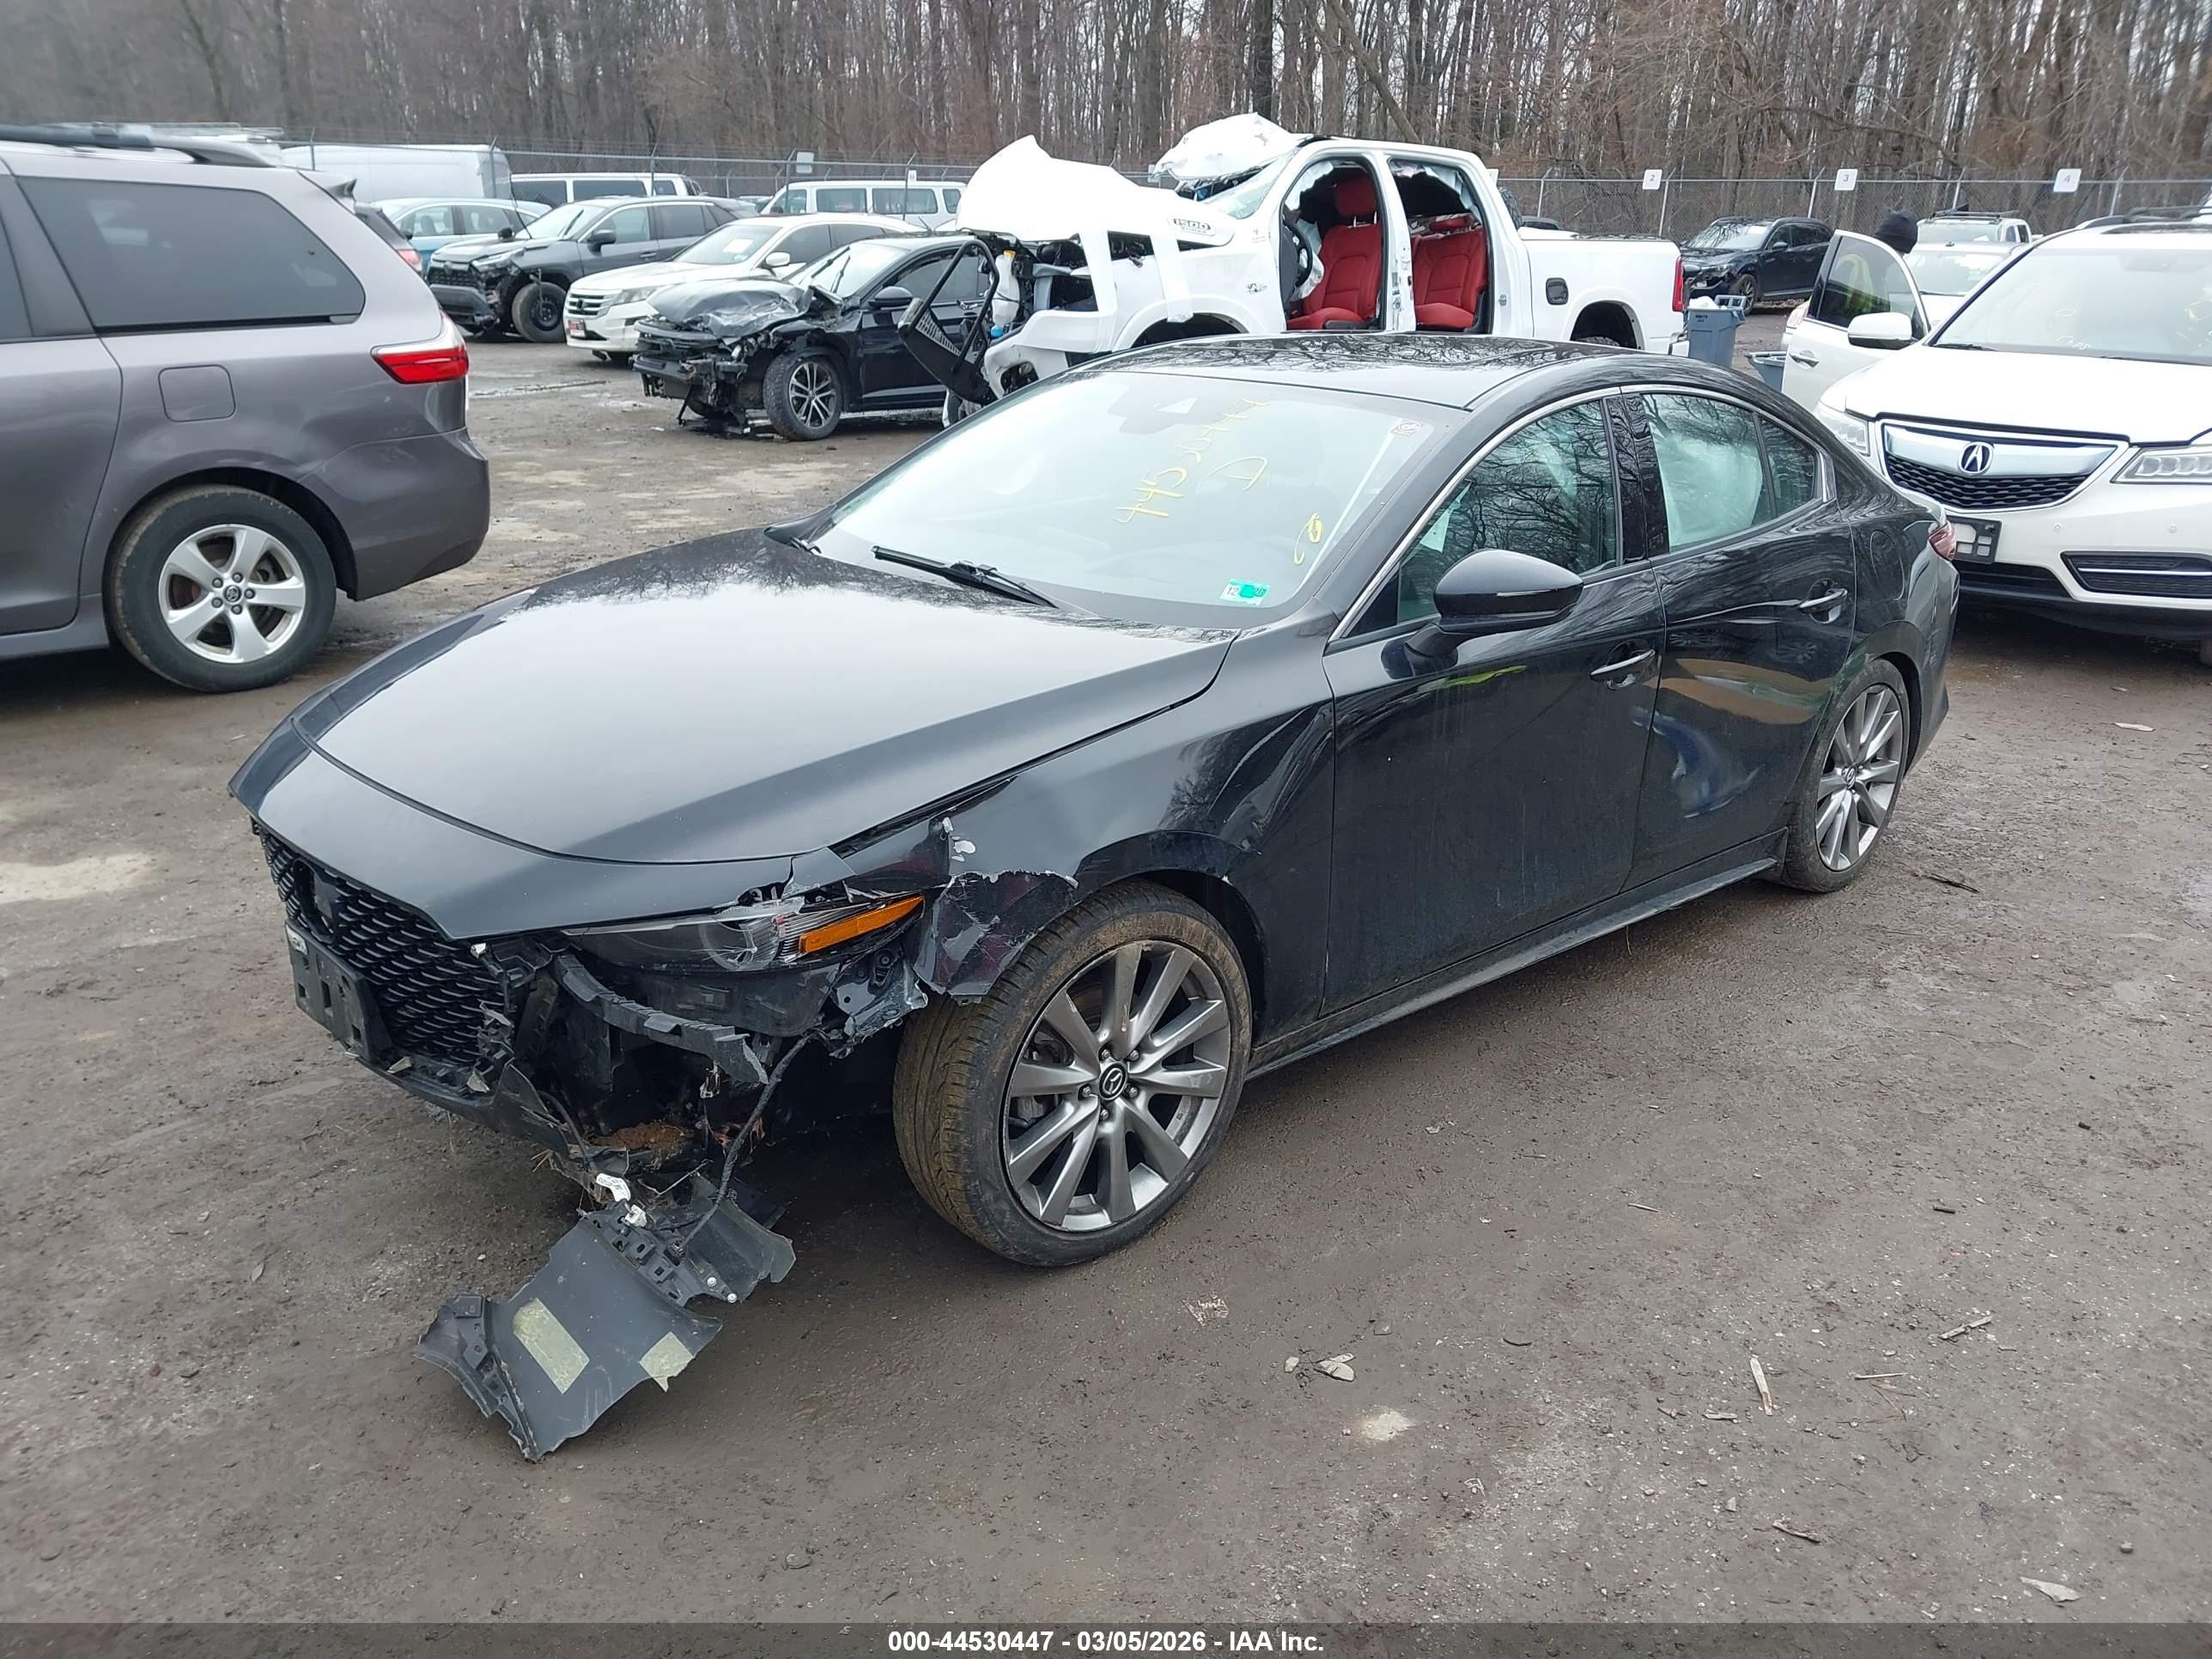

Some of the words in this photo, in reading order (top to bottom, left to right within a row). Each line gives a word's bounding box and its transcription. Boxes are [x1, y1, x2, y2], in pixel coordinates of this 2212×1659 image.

[1649, 173, 1656, 182] 2
[1843, 173, 1850, 182] 3
[2063, 173, 2071, 182] 4
